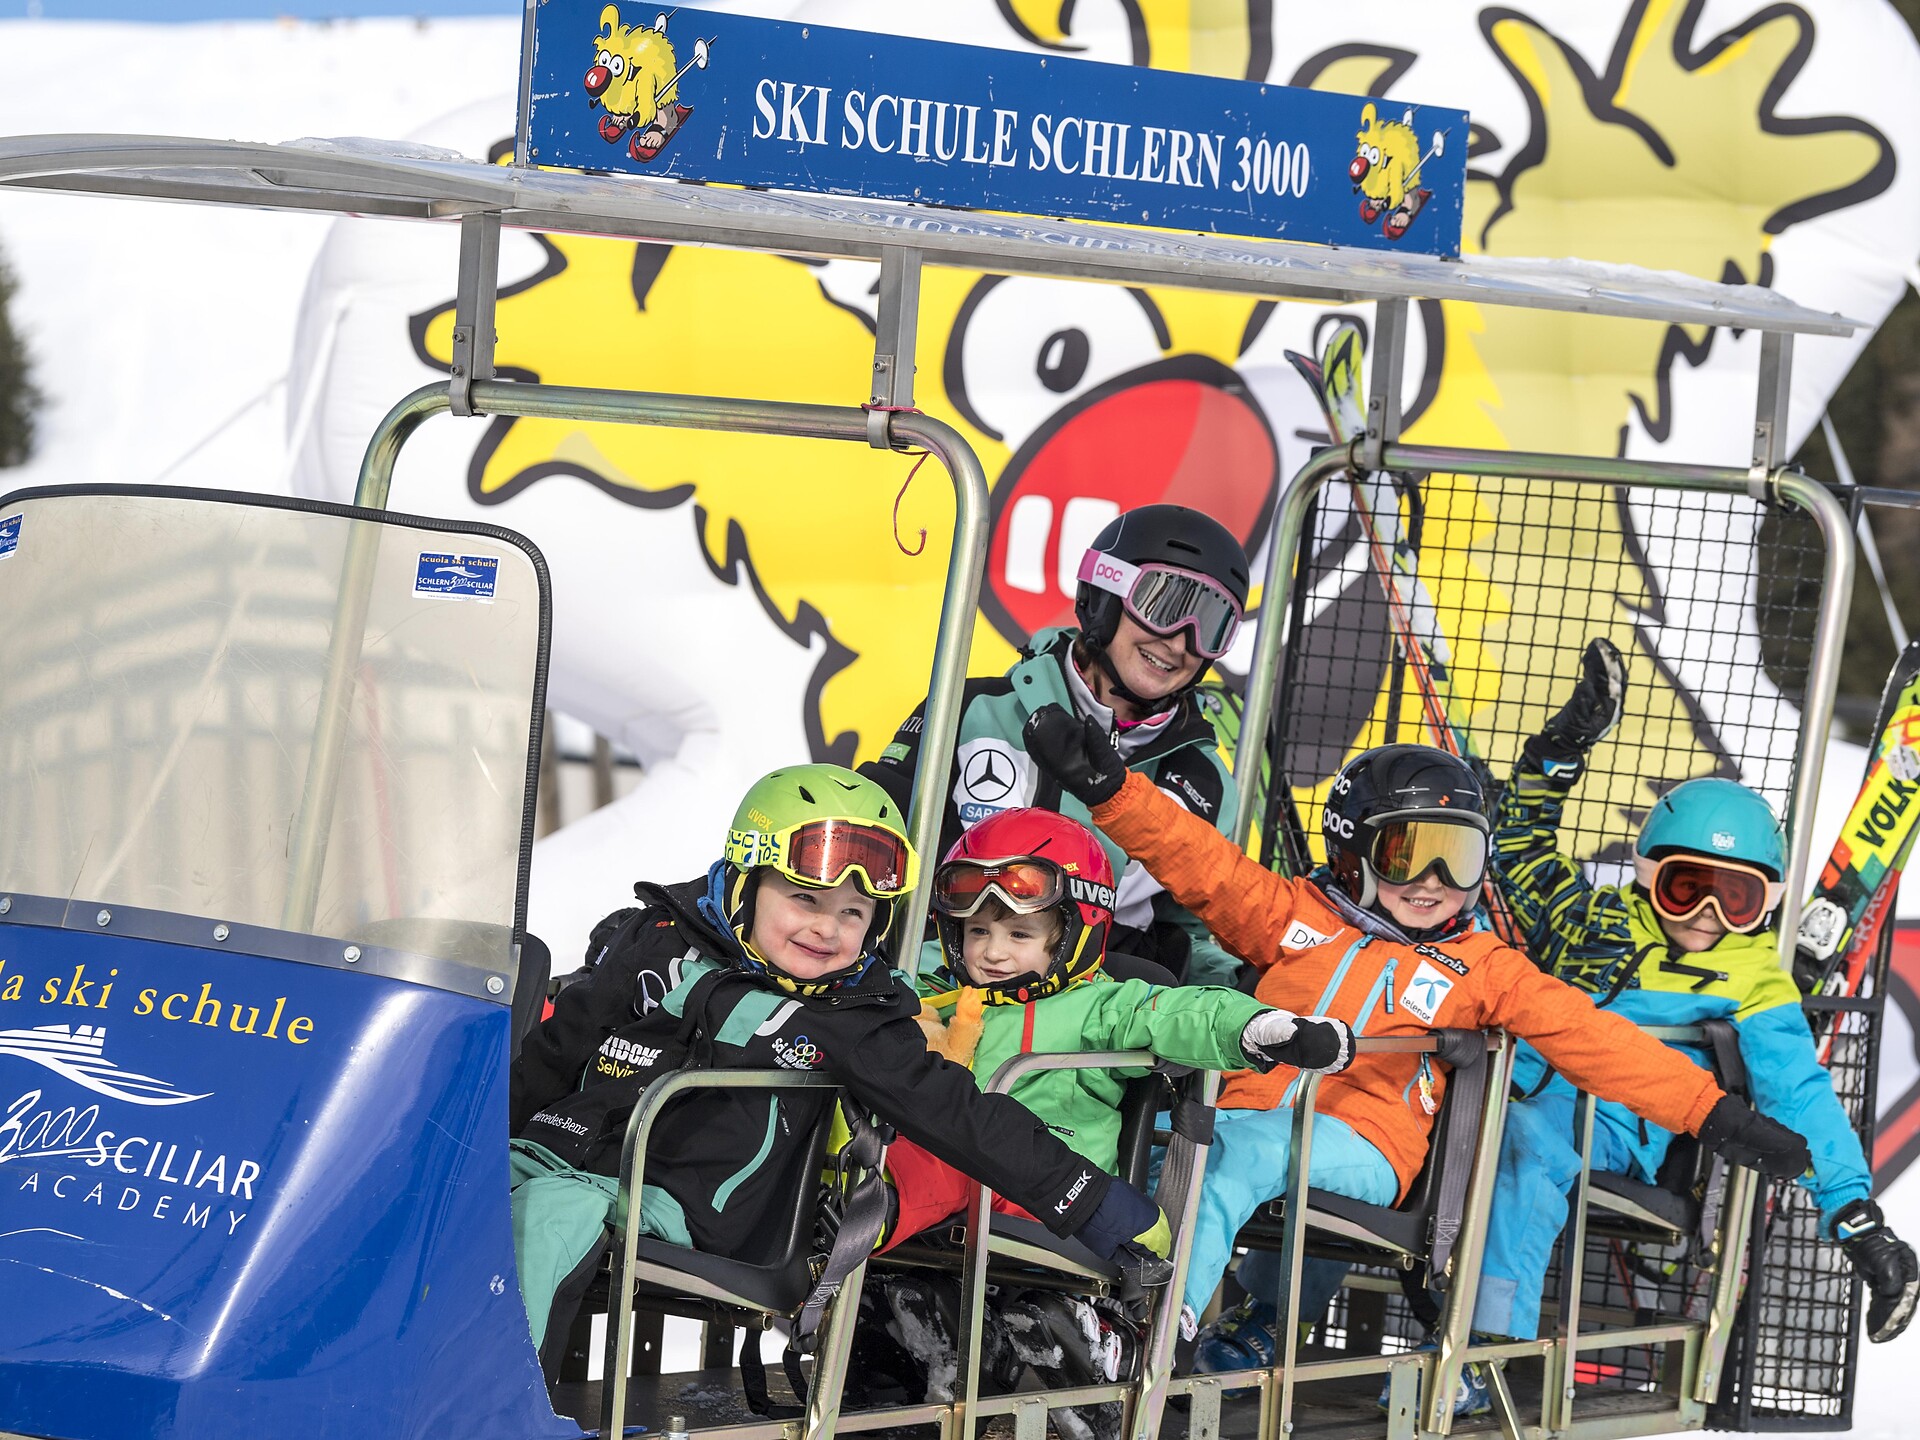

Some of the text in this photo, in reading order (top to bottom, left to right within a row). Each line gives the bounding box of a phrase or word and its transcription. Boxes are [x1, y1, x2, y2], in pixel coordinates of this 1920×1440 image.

[752, 78, 1310, 200] SKI SCHULE SCHLERN 3000
[421, 556, 449, 564] scuola
[468, 560, 497, 568] schule
[1095, 562, 1123, 583] poc
[418, 577, 450, 586] SCHLERN
[467, 581, 494, 590] SCILIAR
[747, 807, 773, 832] uvex
[965, 806, 1000, 819] SAR
[1070, 878, 1116, 912] uvex
[1415, 944, 1468, 976] phenix
[39, 963, 118, 1010] ski
[133, 982, 316, 1046] schule
[1402, 996, 1432, 1022] telenor
[84, 1130, 261, 1201] SCILIAR
[19, 1171, 248, 1237] ACADEMY
